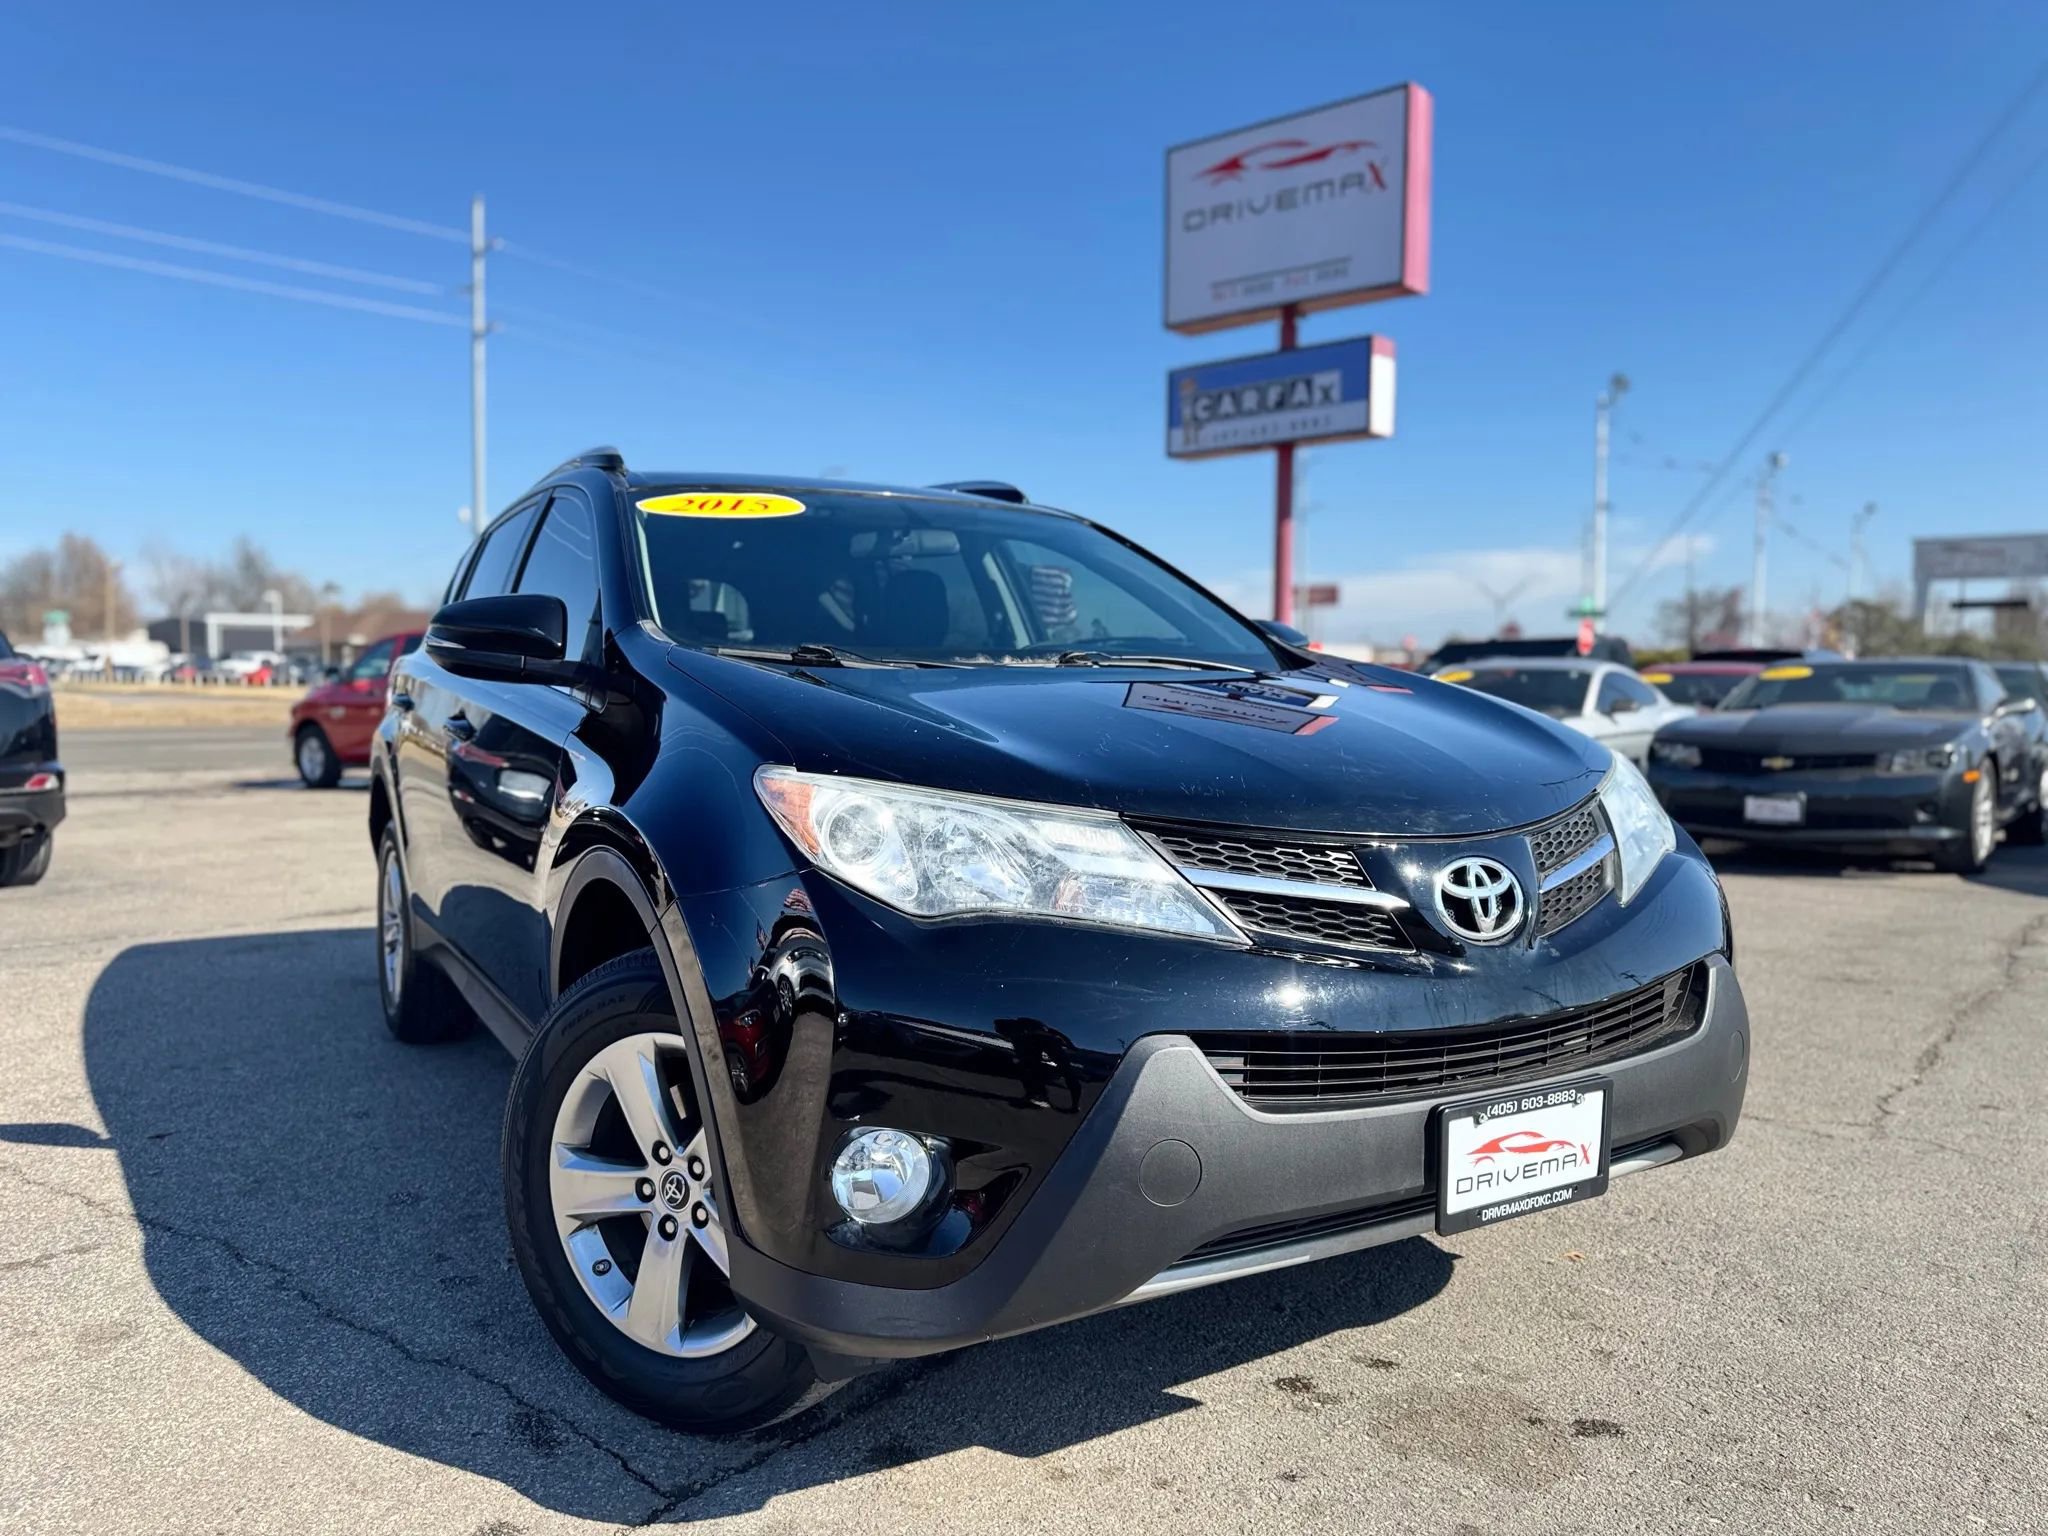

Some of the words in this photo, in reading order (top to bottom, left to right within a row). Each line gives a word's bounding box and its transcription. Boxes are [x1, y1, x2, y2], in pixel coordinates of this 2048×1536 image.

[1183, 157, 1389, 233] DRIVEMAX
[1193, 379, 1337, 421] CARFAX
[672, 499, 771, 512] 2015
[1487, 1100, 1518, 1117] (405)
[1521, 1089, 1576, 1111] 603-8883
[1456, 1142, 1592, 1195] DRIVEMAX
[1481, 1188, 1573, 1221] DRIVEMAXOFOKC.COM
